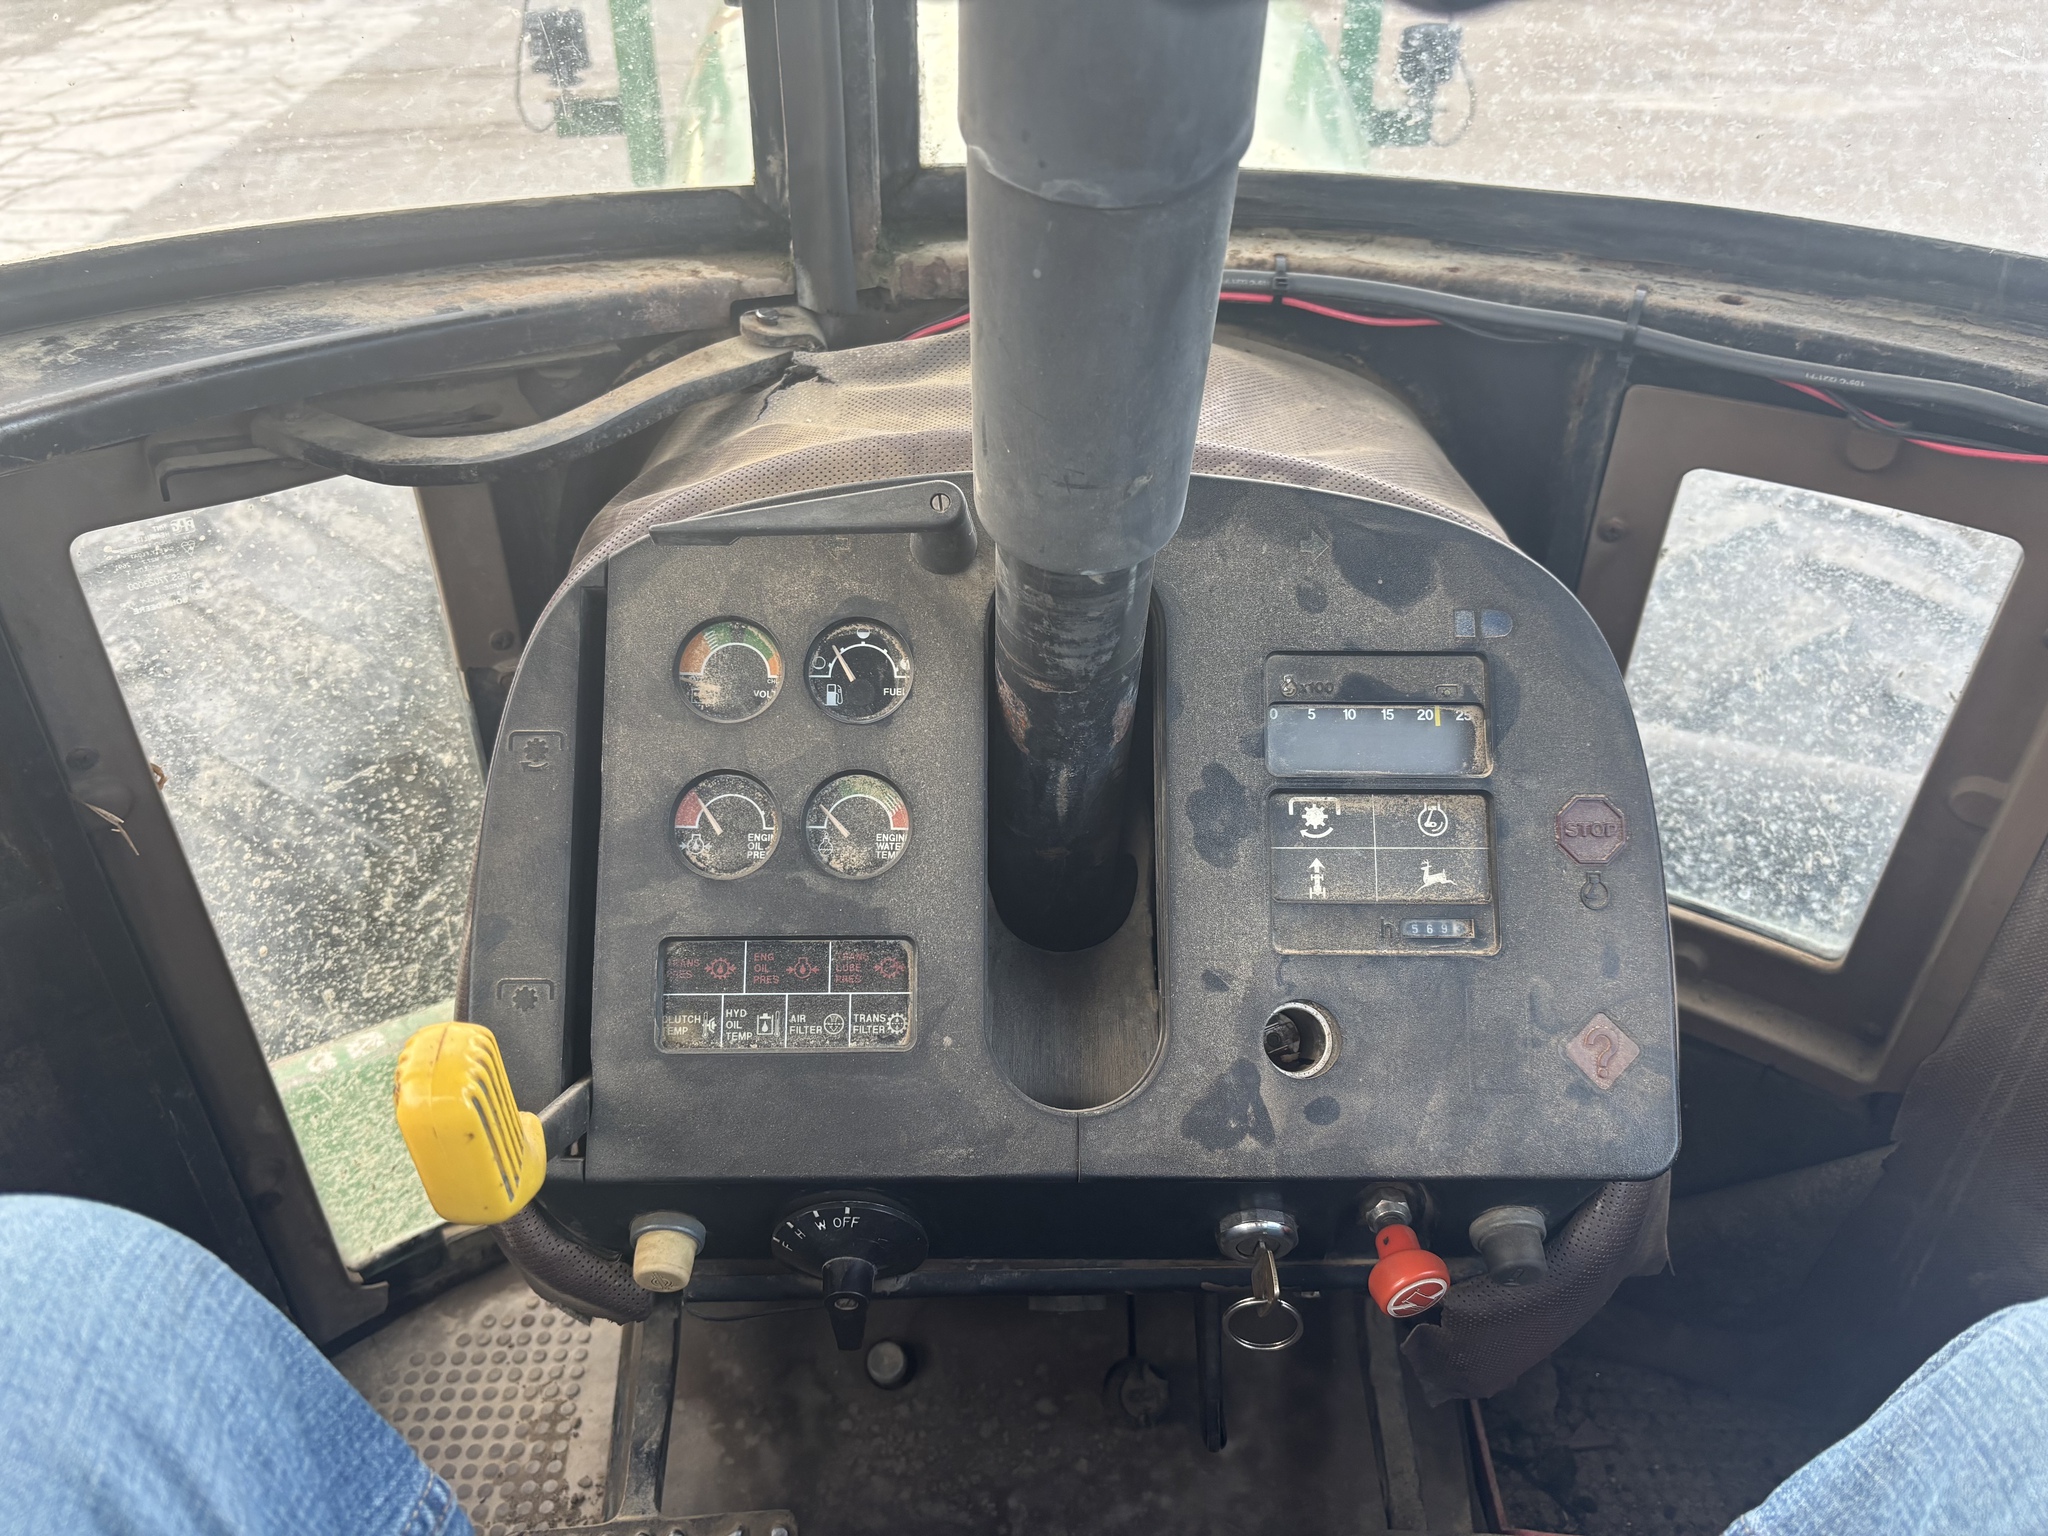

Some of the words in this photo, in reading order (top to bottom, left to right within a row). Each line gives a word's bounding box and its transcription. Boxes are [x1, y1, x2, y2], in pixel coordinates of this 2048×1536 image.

[1269, 709, 1278, 720] 0
[1307, 709, 1316, 720] 5
[1343, 709, 1356, 720] 10
[1381, 709, 1394, 720] 15
[1416, 709, 1434, 720] 20
[1455, 709, 1472, 720] 25
[1563, 820, 1618, 838] STOP
[747, 842, 763, 851] OIL
[753, 952, 775, 962] ENG
[753, 963, 769, 973] OIL
[835, 963, 861, 973] LUBE
[753, 975, 780, 984] PRES
[725, 1009, 748, 1018] HYD
[789, 1014, 807, 1023] AIR
[853, 1013, 887, 1023] TRANS
[662, 1015, 701, 1024] CLUTCH
[725, 1020, 743, 1030] OIL
[789, 1025, 823, 1035] FILTER
[853, 1025, 886, 1035] FILTER
[725, 1031, 753, 1041] TEMP
[814, 1219, 827, 1231] W
[832, 1216, 861, 1229] OFF
[794, 1229, 807, 1240] H
[781, 1241, 793, 1251] F
